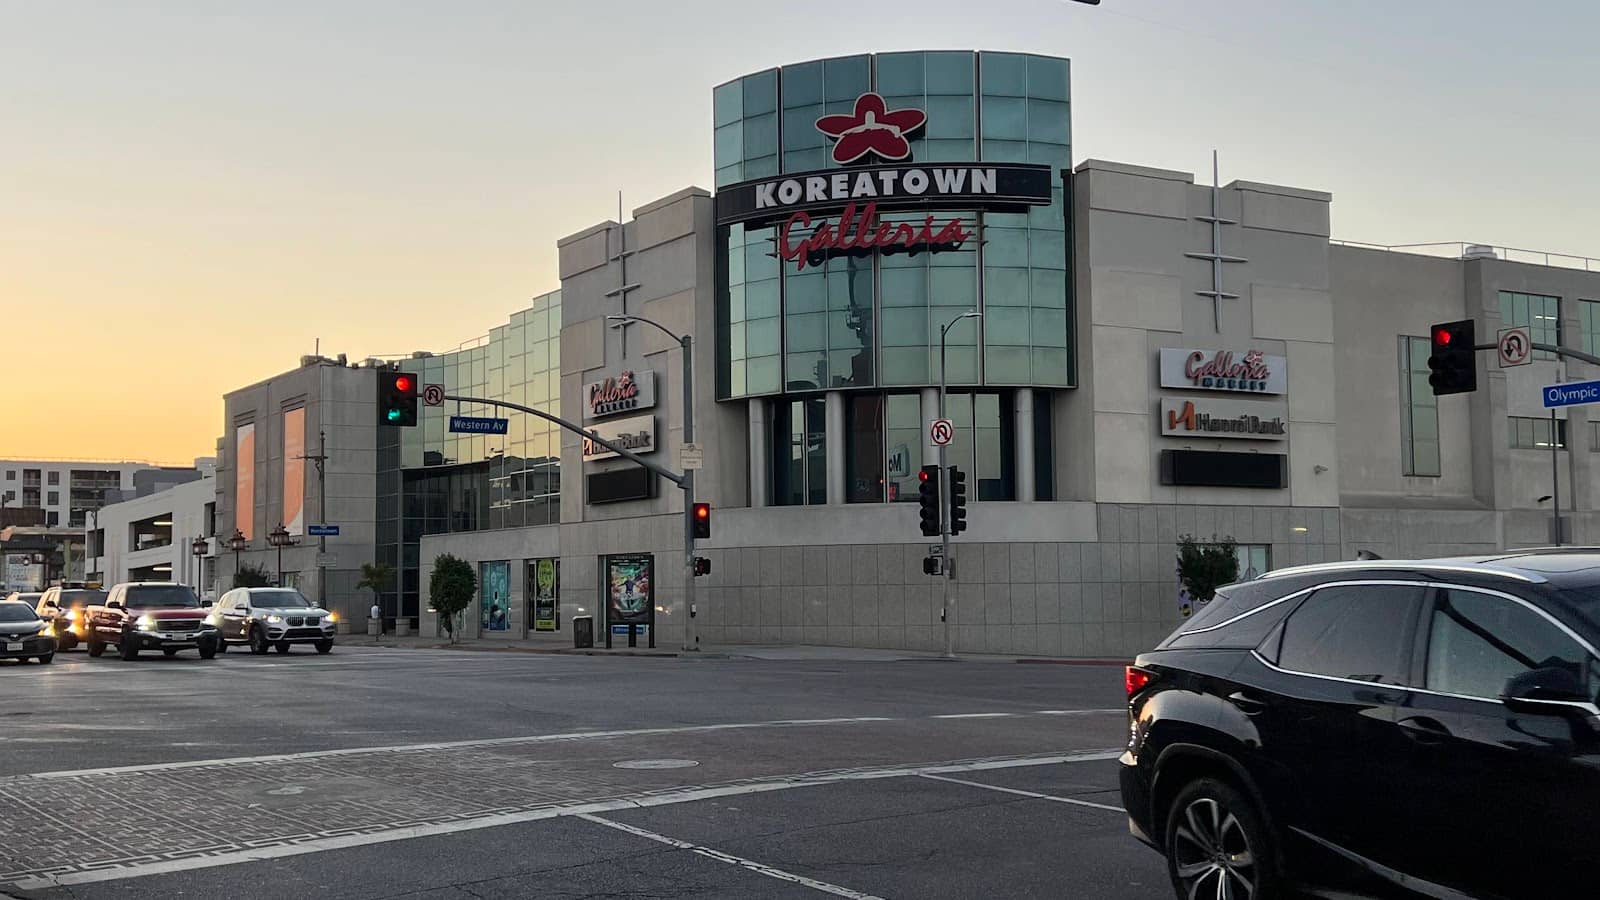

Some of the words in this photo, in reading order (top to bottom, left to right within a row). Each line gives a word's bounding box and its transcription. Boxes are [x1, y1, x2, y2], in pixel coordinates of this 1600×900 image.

[755, 168, 998, 209] KOREATOWN
[780, 201, 972, 272] Galleria
[1185, 350, 1271, 383] Galleria
[1548, 385, 1599, 403] Olympic
[453, 419, 491, 430] Western
[493, 420, 505, 431] Av
